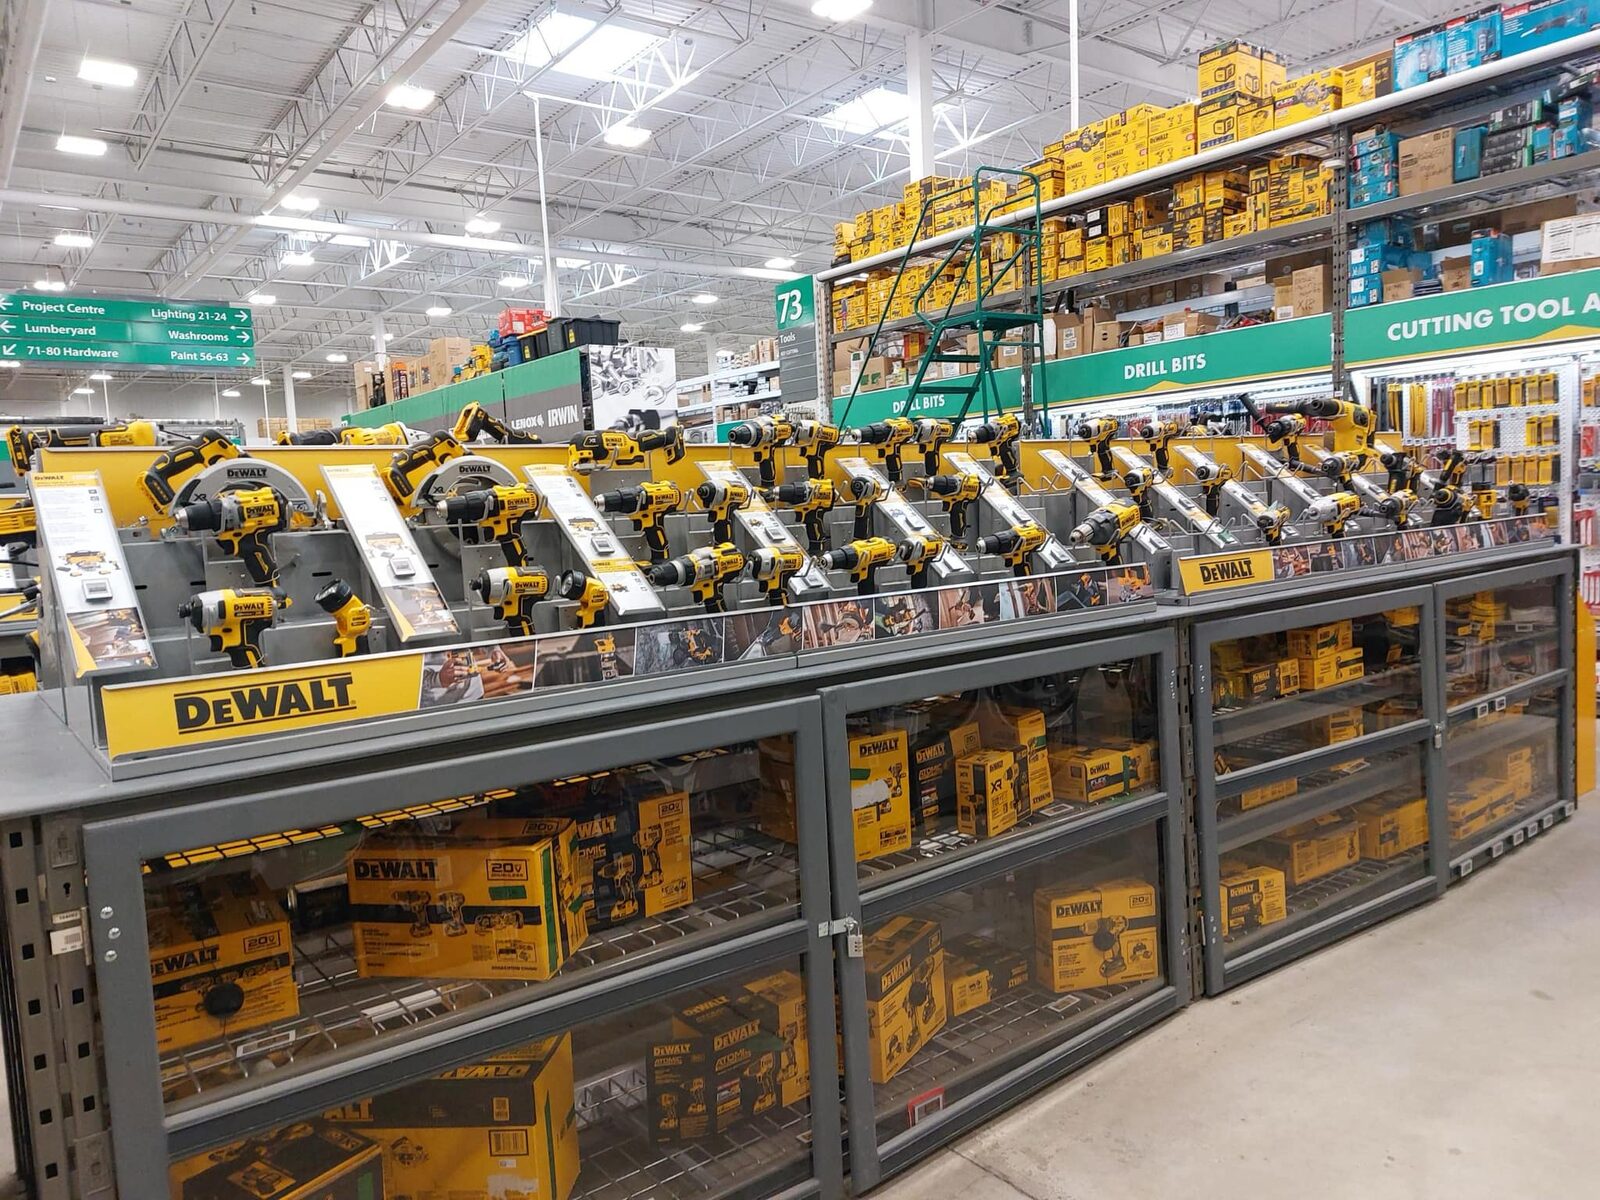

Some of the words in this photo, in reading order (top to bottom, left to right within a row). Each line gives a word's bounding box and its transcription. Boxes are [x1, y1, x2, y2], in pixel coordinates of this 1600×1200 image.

[22, 300, 64, 314] Project
[69, 303, 105, 315] Centre
[777, 289, 803, 324] 73
[151, 308, 195, 321] Lighting
[198, 311, 227, 321] 21-24
[1387, 308, 1494, 341] CUTTING
[1500, 297, 1575, 325] TOOL
[24, 323, 96, 336] Lumberyard
[168, 330, 229, 342] Washrooms
[780, 333, 796, 344] Tools
[26, 346, 61, 356] 71-80
[63, 347, 119, 358] Hardware
[171, 351, 198, 361] Paint
[200, 352, 229, 362] 56-63
[1124, 360, 1167, 380] DRILL
[1171, 353, 1207, 373] BITS
[923, 393, 945, 411] BITS
[511, 415, 538, 429] LENOX
[548, 405, 580, 428] IRWIN
[227, 468, 267, 479] DEWALT
[459, 465, 491, 473] DEWALT
[194, 493, 207, 501] XR
[433, 486, 445, 494] XR
[507, 497, 530, 506] DEWALT
[246, 504, 274, 514] DEWALT
[1200, 559, 1253, 583] DEWALT
[515, 581, 540, 589] DEWALT
[233, 602, 265, 612] DEWALT
[174, 675, 354, 731] DEWALT
[859, 738, 899, 757] DEWALT
[915, 742, 945, 764] DEWALT
[1089, 762, 1110, 775] DEWALT
[990, 779, 1002, 793] XR
[577, 816, 617, 838] WALT
[354, 859, 437, 881] DEWALT
[491, 862, 523, 873] 20V
[1056, 900, 1102, 918] DEWALT
[881, 955, 912, 993] DEWALT
[683, 996, 730, 1017] DEWALT
[713, 1019, 761, 1051] DEWALT
[654, 1043, 691, 1056] DEWALT
